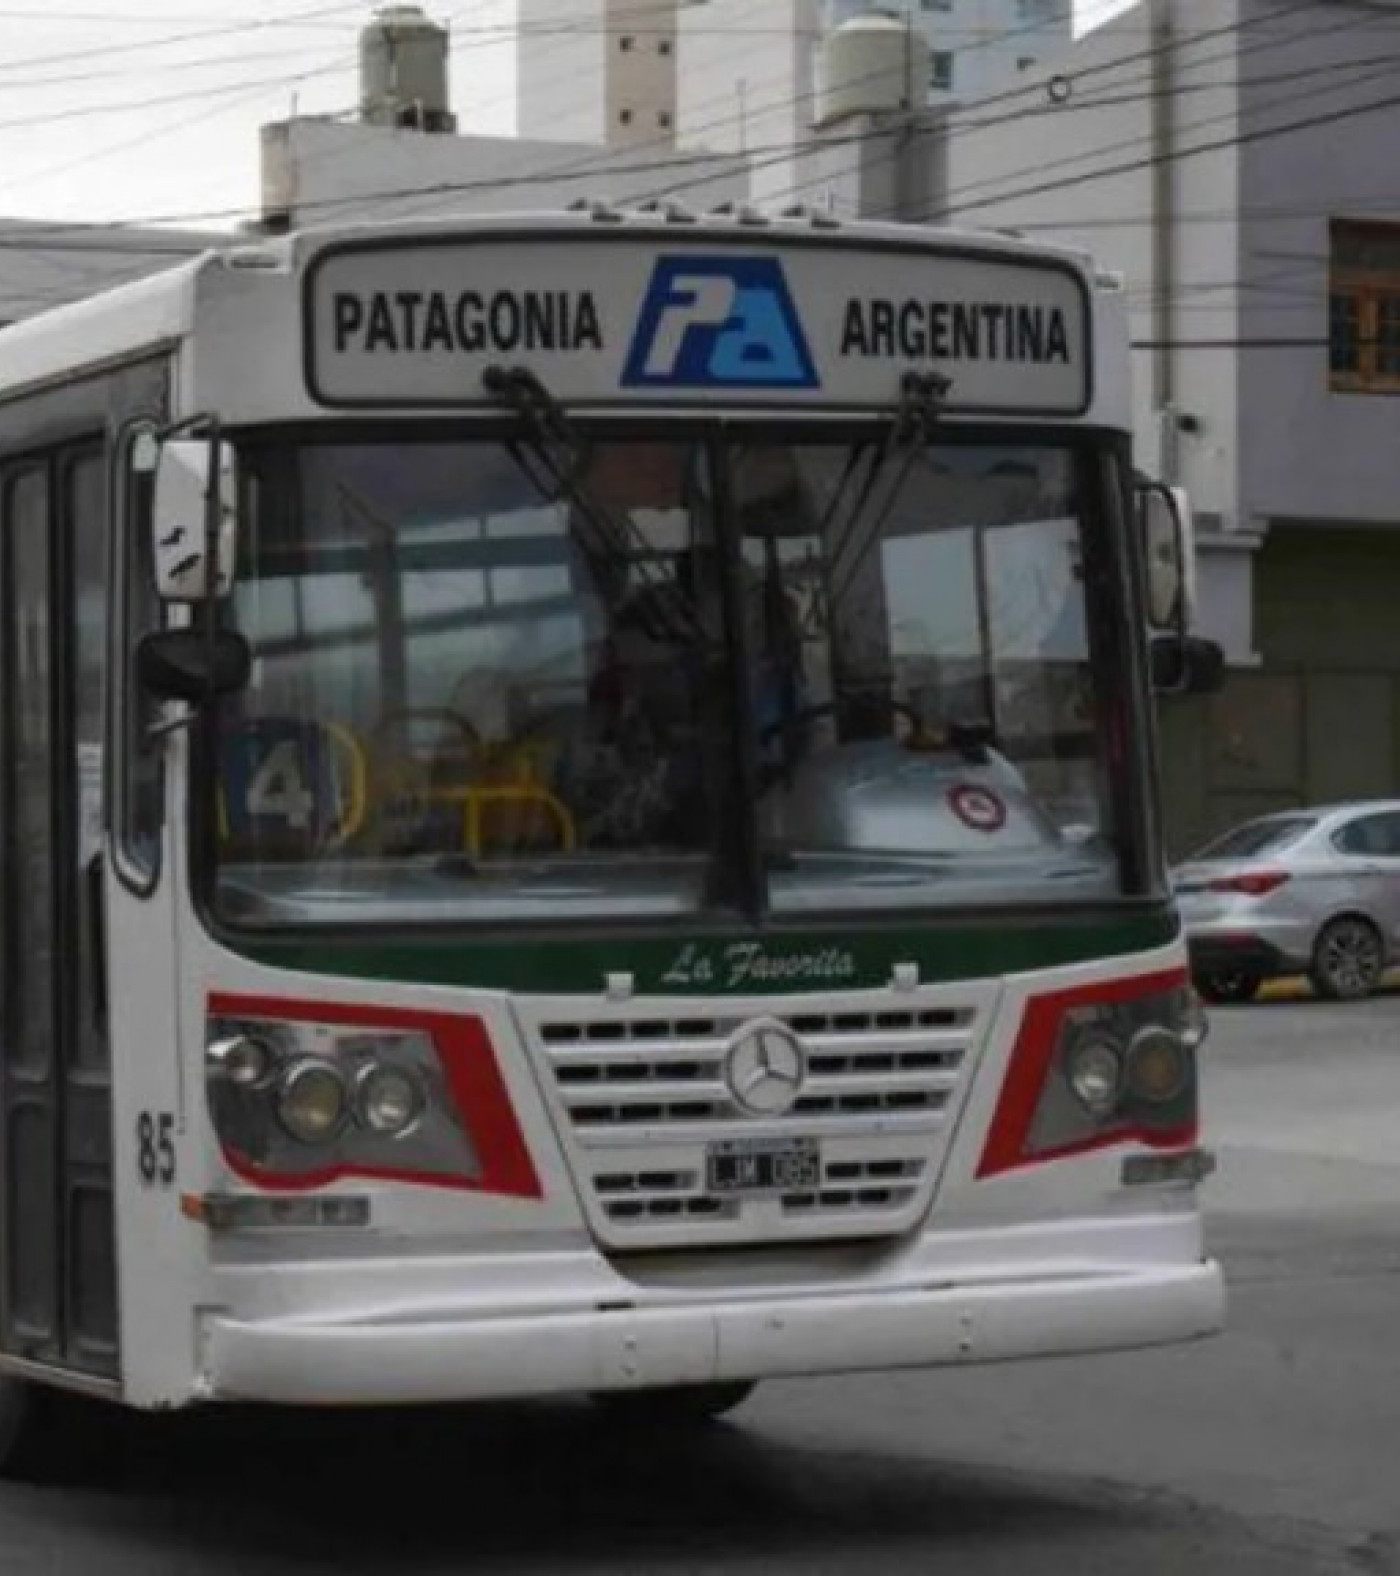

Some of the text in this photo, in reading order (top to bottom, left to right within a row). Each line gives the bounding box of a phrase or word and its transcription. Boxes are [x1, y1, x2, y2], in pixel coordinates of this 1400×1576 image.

[334, 290, 603, 352] PATAGONIA
[841, 299, 1069, 364] ARGENTINA
[244, 740, 314, 829] 4
[661, 942, 854, 986] La Favorita
[138, 1111, 175, 1183] 85
